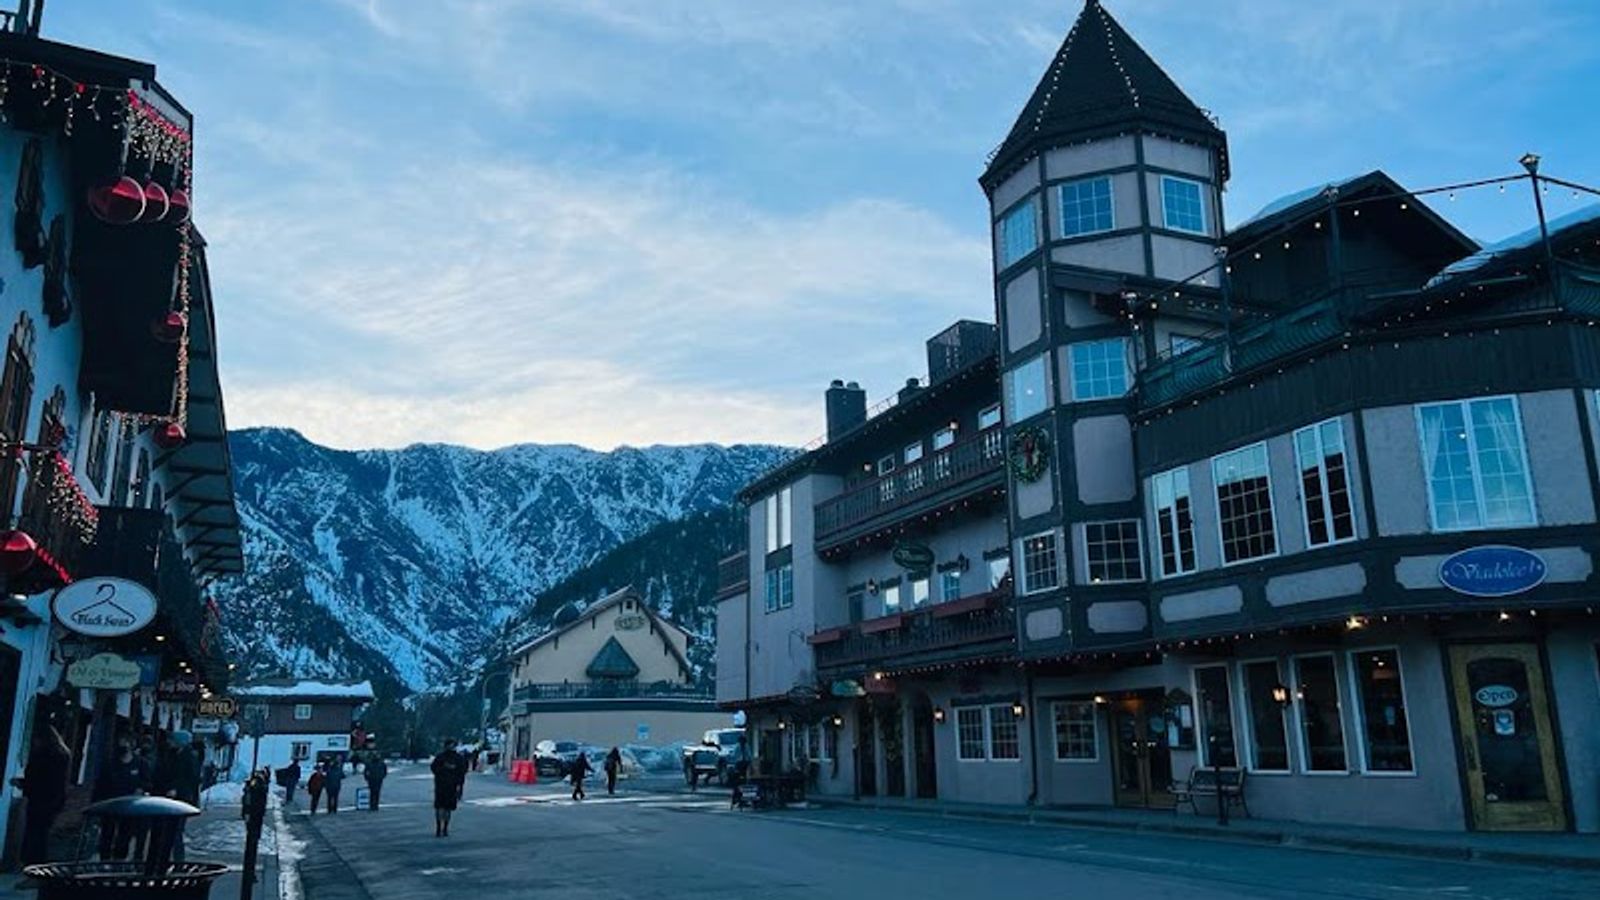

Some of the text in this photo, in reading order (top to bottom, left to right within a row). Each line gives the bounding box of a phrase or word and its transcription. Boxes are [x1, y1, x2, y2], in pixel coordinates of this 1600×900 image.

[78, 613, 130, 627] Black Swan
[199, 702, 232, 714] HOTEL
